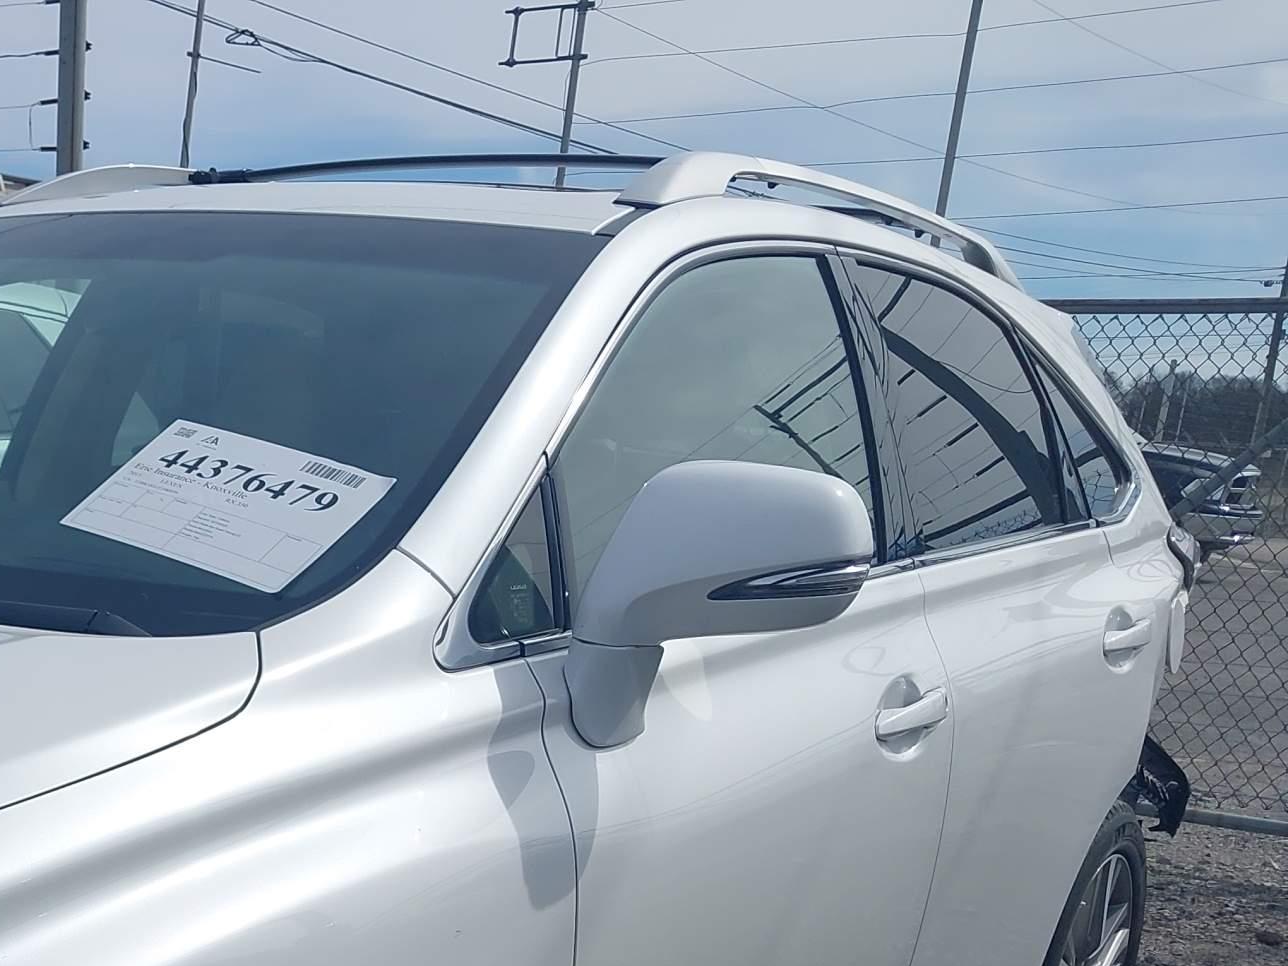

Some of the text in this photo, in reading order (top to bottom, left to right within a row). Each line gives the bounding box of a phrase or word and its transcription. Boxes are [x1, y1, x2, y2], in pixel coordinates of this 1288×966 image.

[153, 467, 196, 483] Insurance
[202, 480, 248, 500] Knoxville
[158, 449, 339, 511] 44376479
